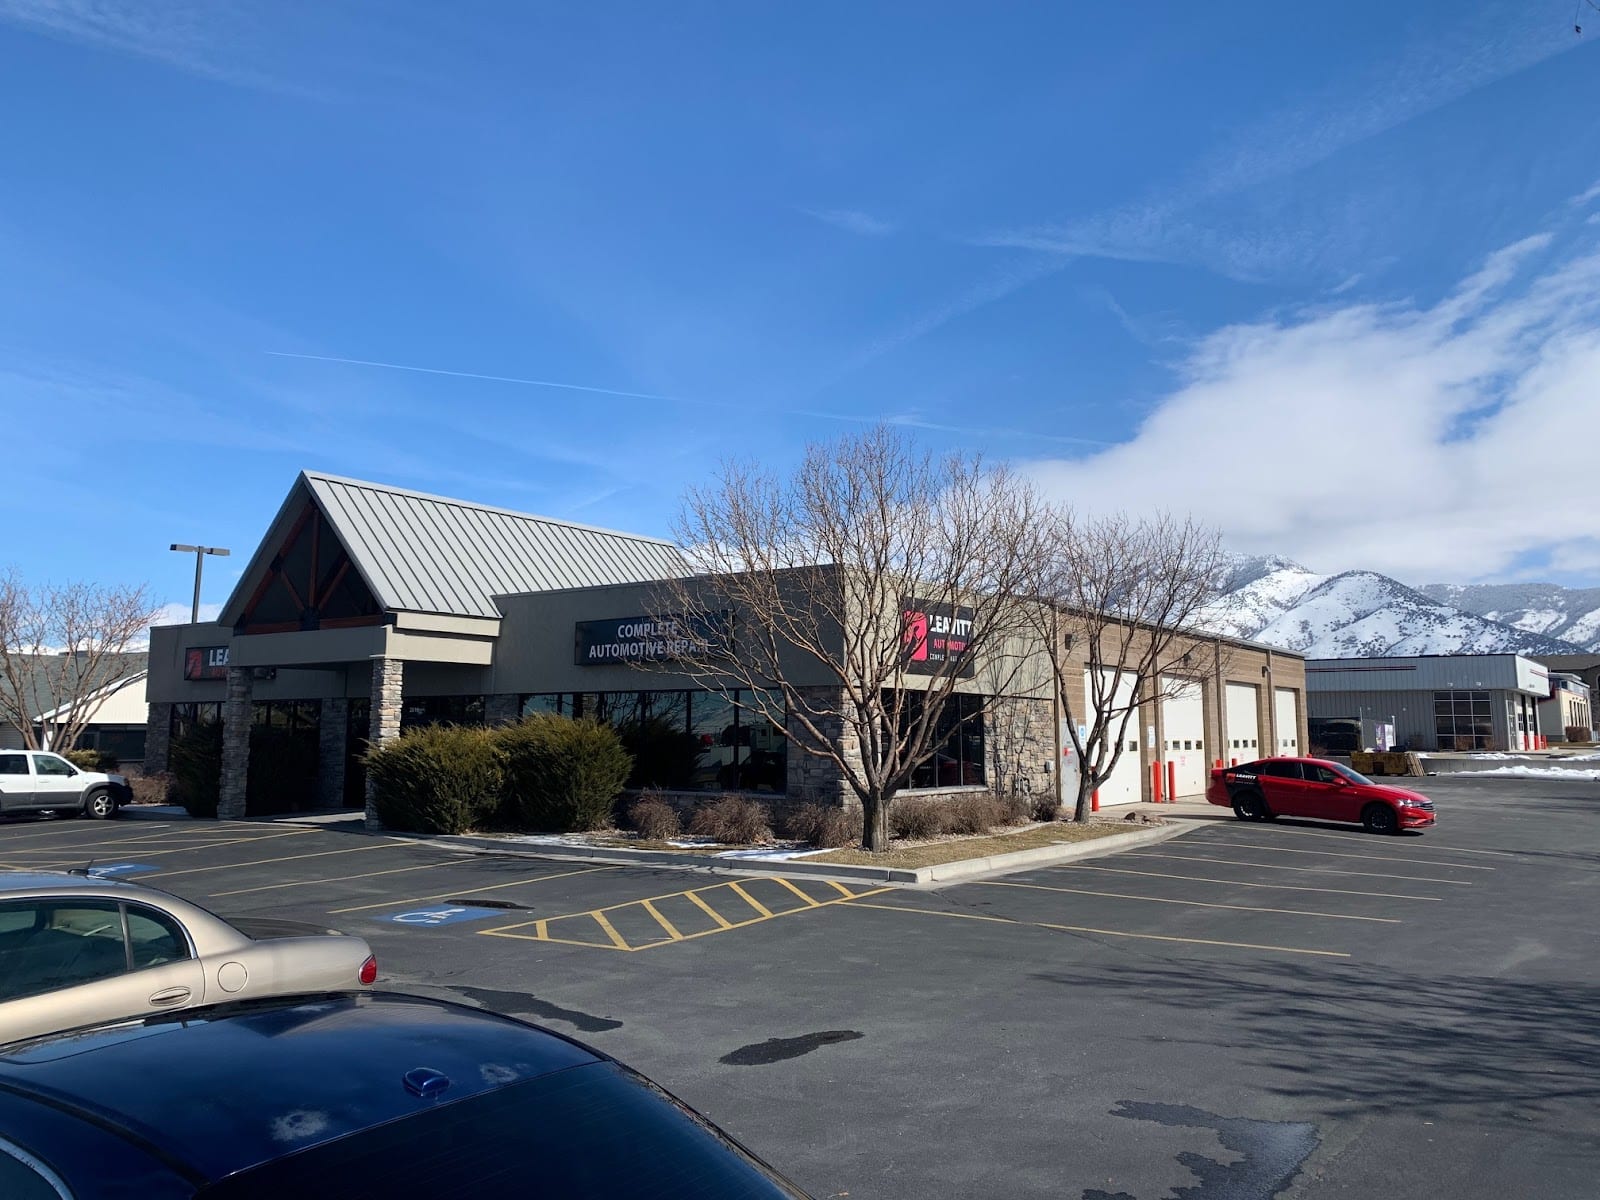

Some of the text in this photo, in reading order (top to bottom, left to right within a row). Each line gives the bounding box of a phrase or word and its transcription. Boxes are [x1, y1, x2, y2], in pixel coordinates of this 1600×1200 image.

[617, 622, 677, 638] COMPLETE
[589, 640, 664, 658] AUTOMOTIVE
[933, 638, 970, 652] AUTMOTI
